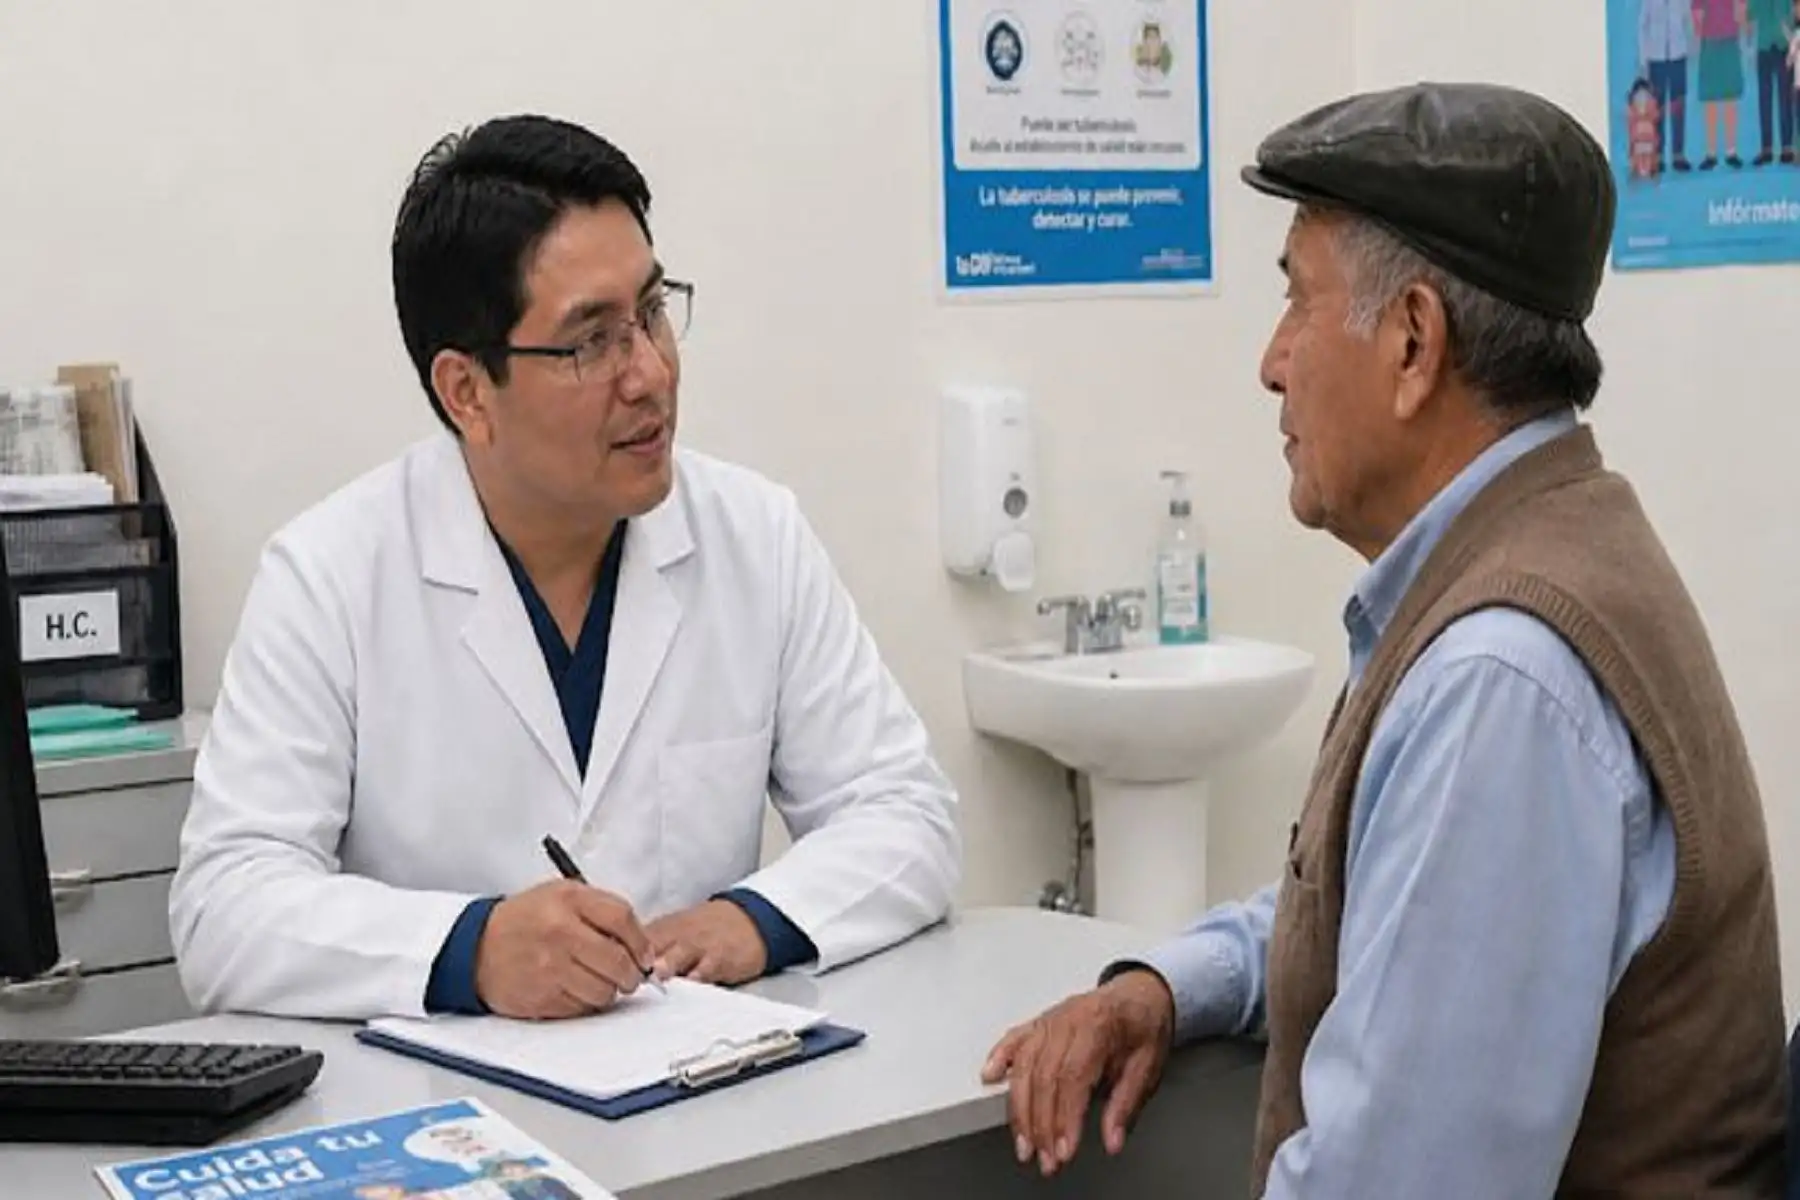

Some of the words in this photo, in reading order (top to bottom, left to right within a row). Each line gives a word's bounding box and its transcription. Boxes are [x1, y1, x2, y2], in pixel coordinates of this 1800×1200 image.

[979, 185, 996, 206] La
[998, 184, 1076, 206] tuberculosis
[1078, 188, 1091, 206] se
[1094, 184, 1128, 210] puede
[1032, 209, 1084, 230] detectar
[1085, 213, 1095, 234] y
[1097, 212, 1133, 229] curar.
[46, 611, 97, 640] H.C.
[134, 1147, 308, 1191] Cuida
[316, 1130, 384, 1151] tu
